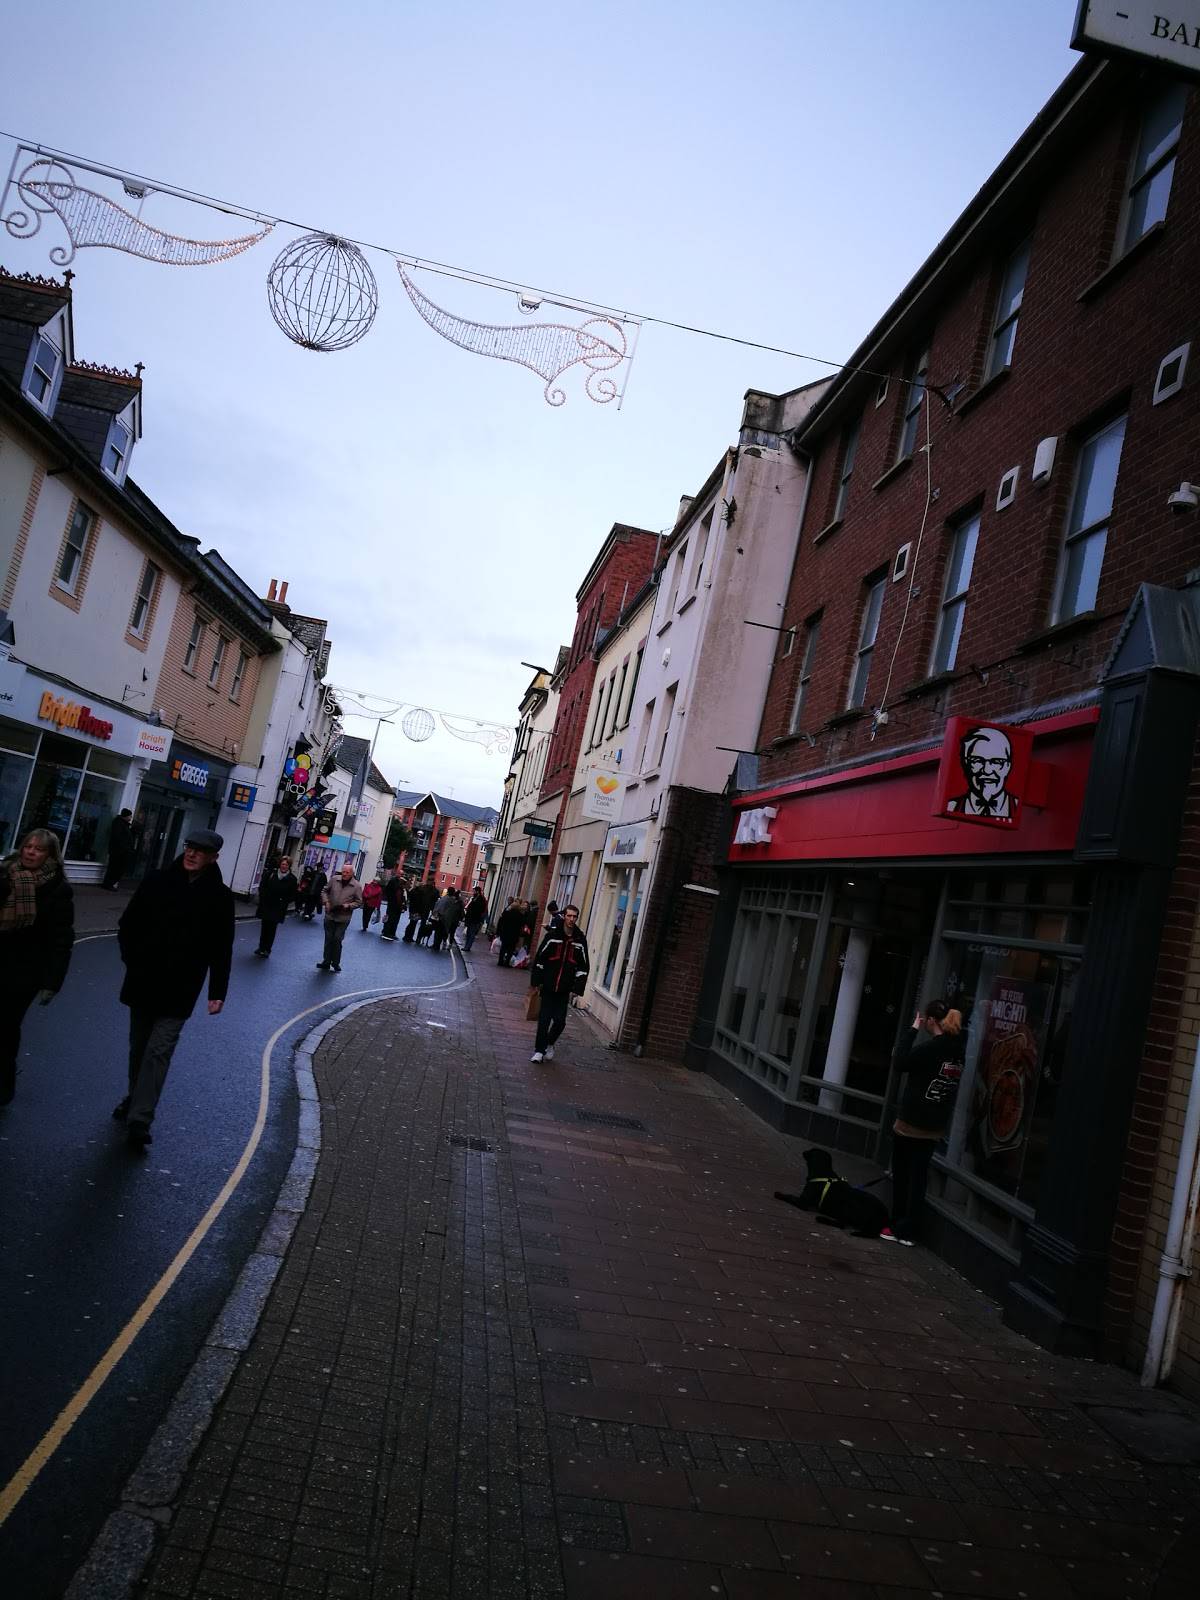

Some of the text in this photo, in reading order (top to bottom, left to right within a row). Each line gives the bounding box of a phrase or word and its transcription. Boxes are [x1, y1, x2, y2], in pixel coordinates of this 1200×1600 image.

[140, 731, 167, 745] Bright
[138, 741, 165, 753] House
[180, 762, 208, 787] GREGGS
